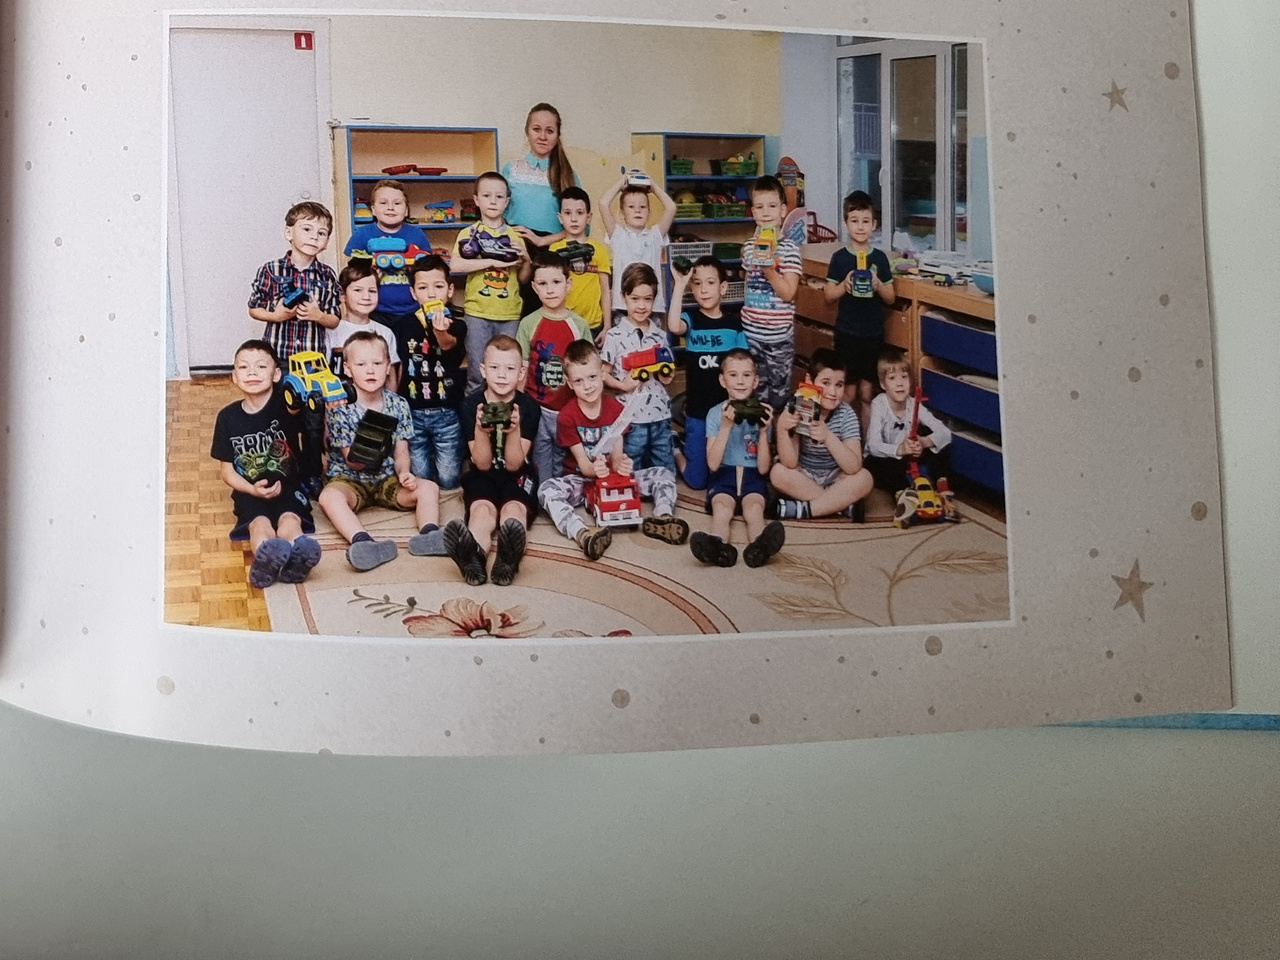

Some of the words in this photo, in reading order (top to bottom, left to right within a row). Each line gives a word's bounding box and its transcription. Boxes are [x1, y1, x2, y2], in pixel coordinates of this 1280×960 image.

[690, 334, 710, 346] WILL
[710, 335, 723, 347] BE
[698, 354, 719, 369] OK
